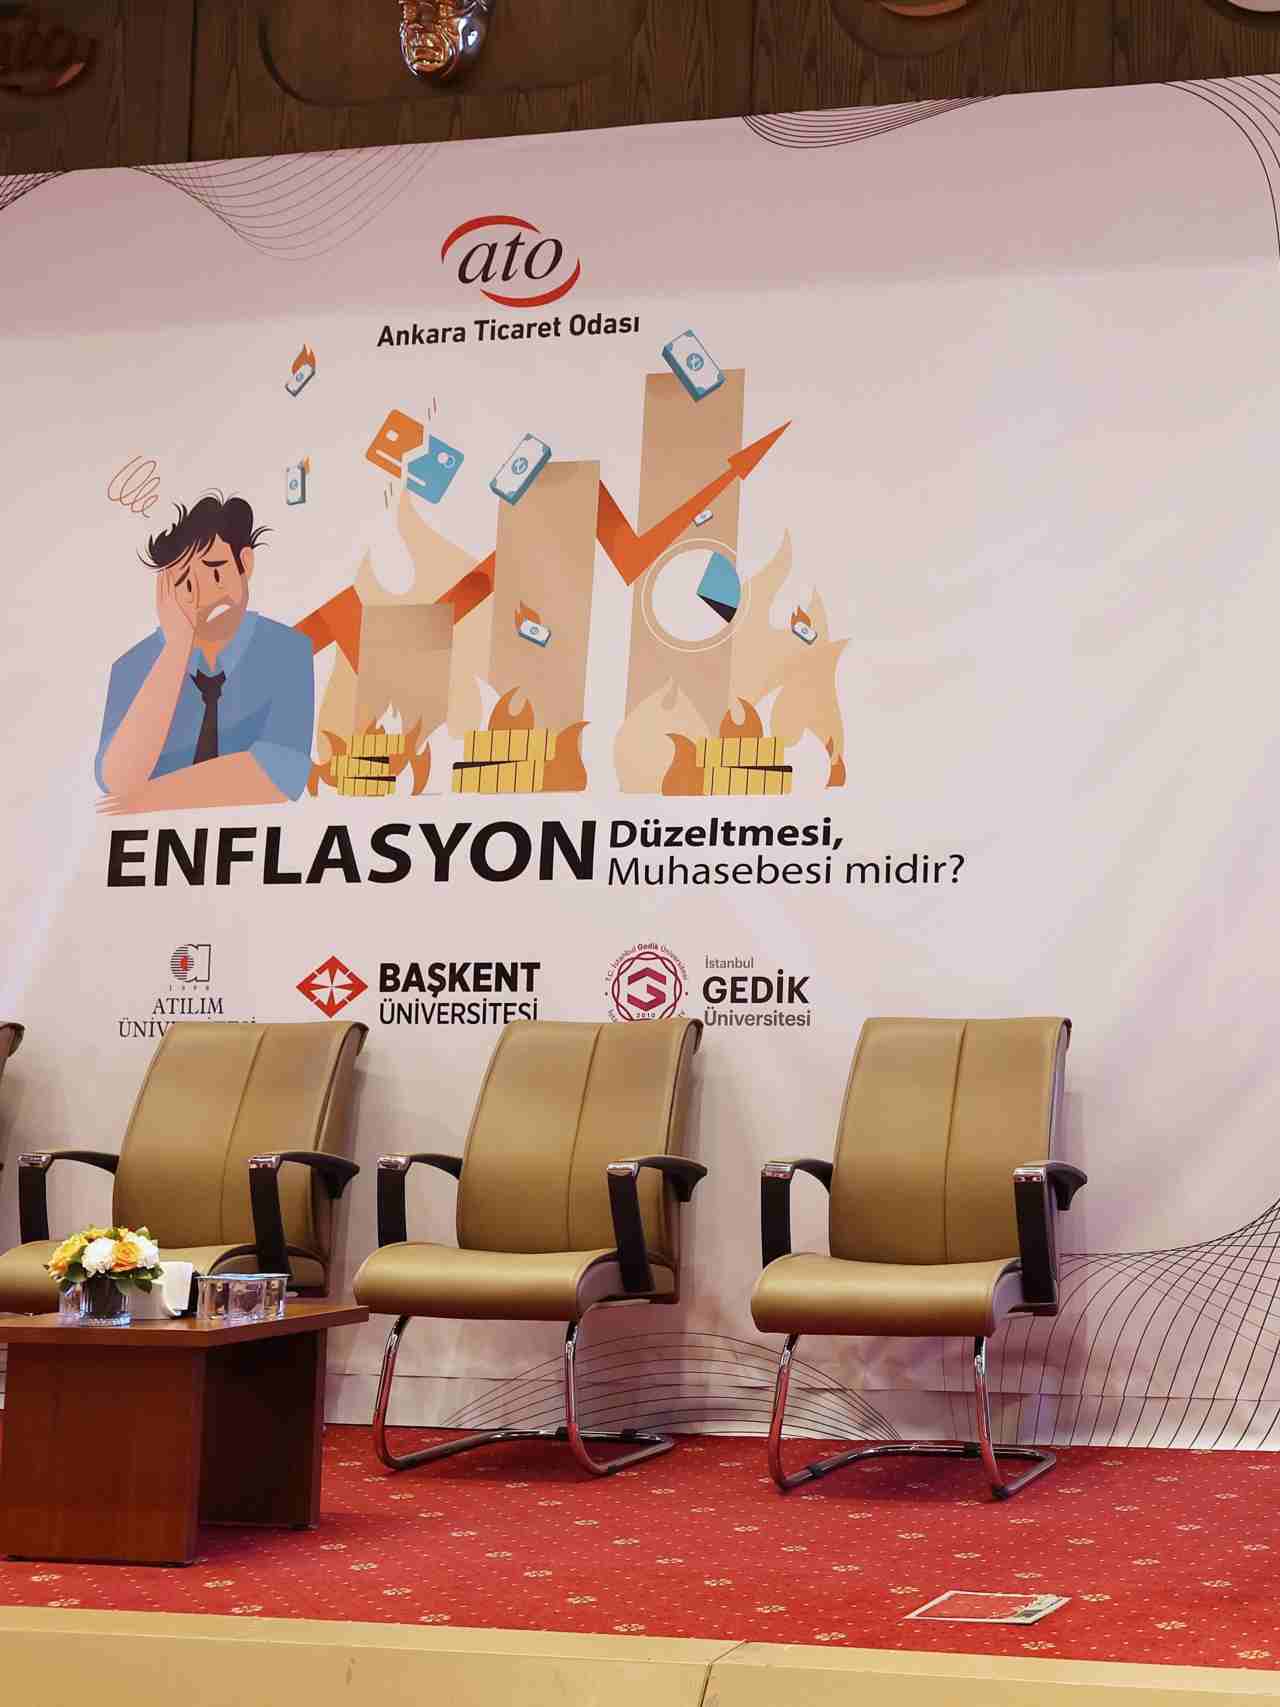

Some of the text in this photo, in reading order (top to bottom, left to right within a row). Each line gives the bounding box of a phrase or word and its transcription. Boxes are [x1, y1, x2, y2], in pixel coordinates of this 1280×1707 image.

[457, 231, 563, 284] ato
[377, 312, 640, 347] Ankara Ticaret Odası
[609, 817, 844, 850] Düzeltmesi,
[106, 819, 597, 888] ENFLASYON
[608, 853, 965, 886] Muhasebesi midir?
[705, 954, 755, 969] İstanbul
[379, 962, 541, 998] BAŞKENT
[702, 969, 810, 1005] GEDİK
[152, 997, 224, 1015] ATILIM
[379, 998, 538, 1025] ÜNİVERSİTESİ
[704, 1006, 811, 1027] Üniversitesi
